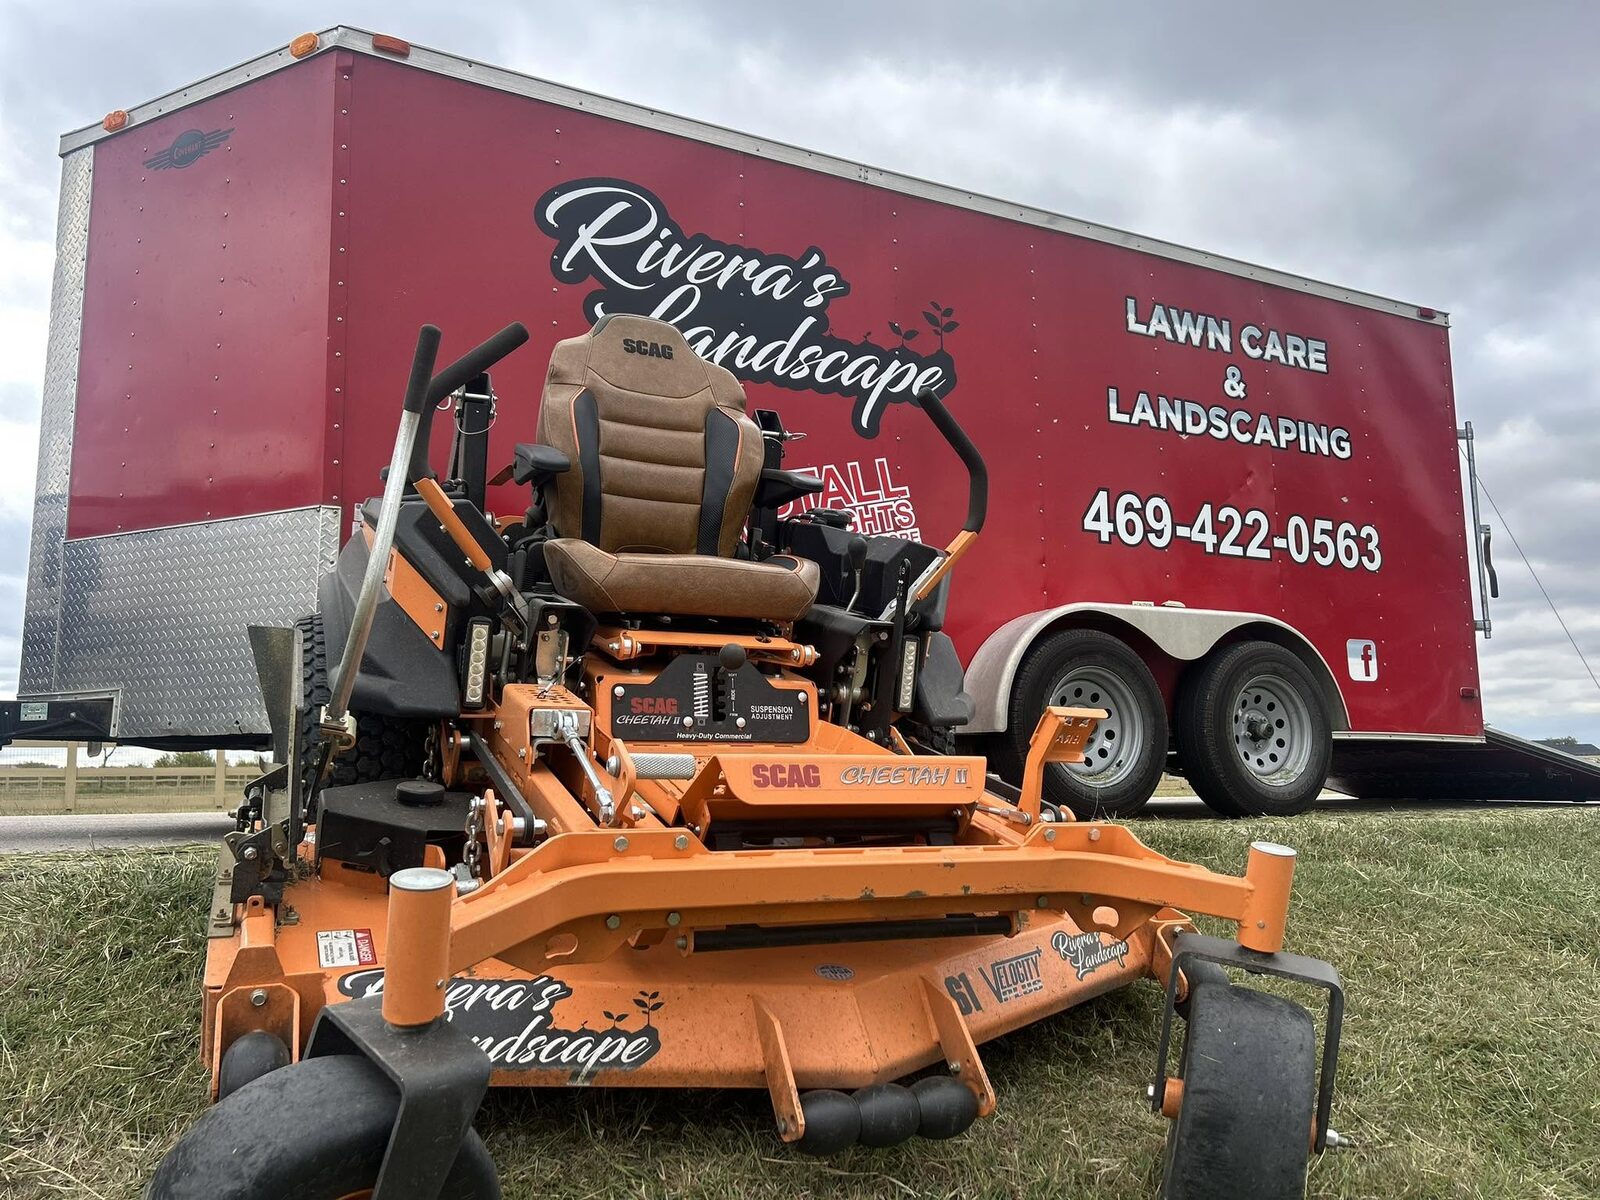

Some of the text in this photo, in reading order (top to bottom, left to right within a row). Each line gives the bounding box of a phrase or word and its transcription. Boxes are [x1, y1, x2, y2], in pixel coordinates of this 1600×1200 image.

[545, 186, 845, 308] Rivera's
[623, 338, 674, 361] SCAG
[1126, 298, 1328, 373] LAWN CARE
[1223, 365, 1247, 399] &
[1108, 387, 1352, 460] LANDSCAPING
[1083, 490, 1382, 572] 469-422-0563
[616, 715, 680, 726] CHEETAH II
[630, 697, 679, 715] SCAG
[750, 705, 793, 714] SUSPENSION
[676, 732, 714, 740] Heavy-Duty
[752, 764, 821, 788] SCAG
[840, 765, 967, 786] CHEETAH II
[1071, 941, 1128, 979] Landscape
[977, 947, 1042, 1003] VELOCITY
